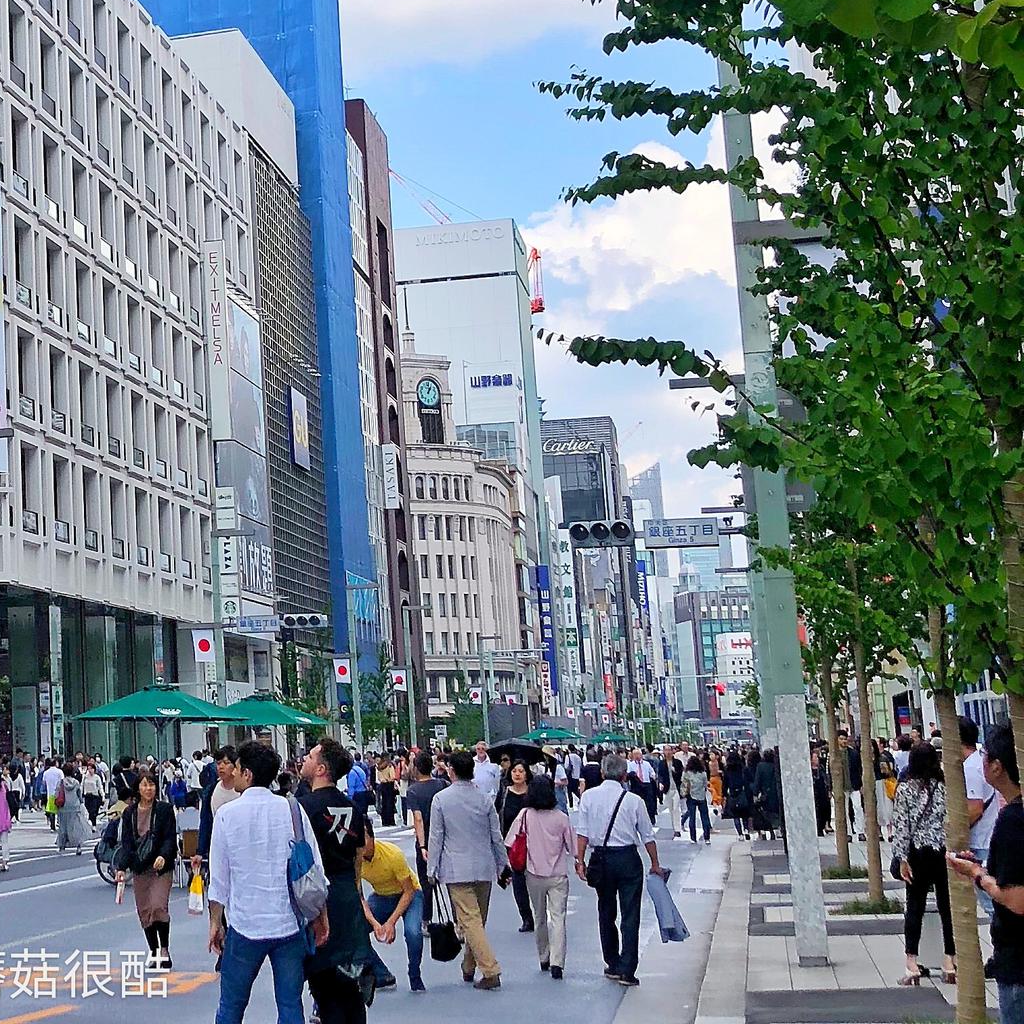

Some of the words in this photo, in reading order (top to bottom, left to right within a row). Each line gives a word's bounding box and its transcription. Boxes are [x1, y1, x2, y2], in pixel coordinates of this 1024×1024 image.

[415, 227, 505, 247] MIKIMOTO
[293, 408, 309, 446] GU
[543, 438, 599, 455] Cartier
[385, 451, 397, 502] TASAKI
[648, 524, 714, 537] 銀座五丁目
[668, 536, 688, 544] Ginza
[559, 540, 573, 599] 教文館
[637, 571, 647, 605] MIZUHO
